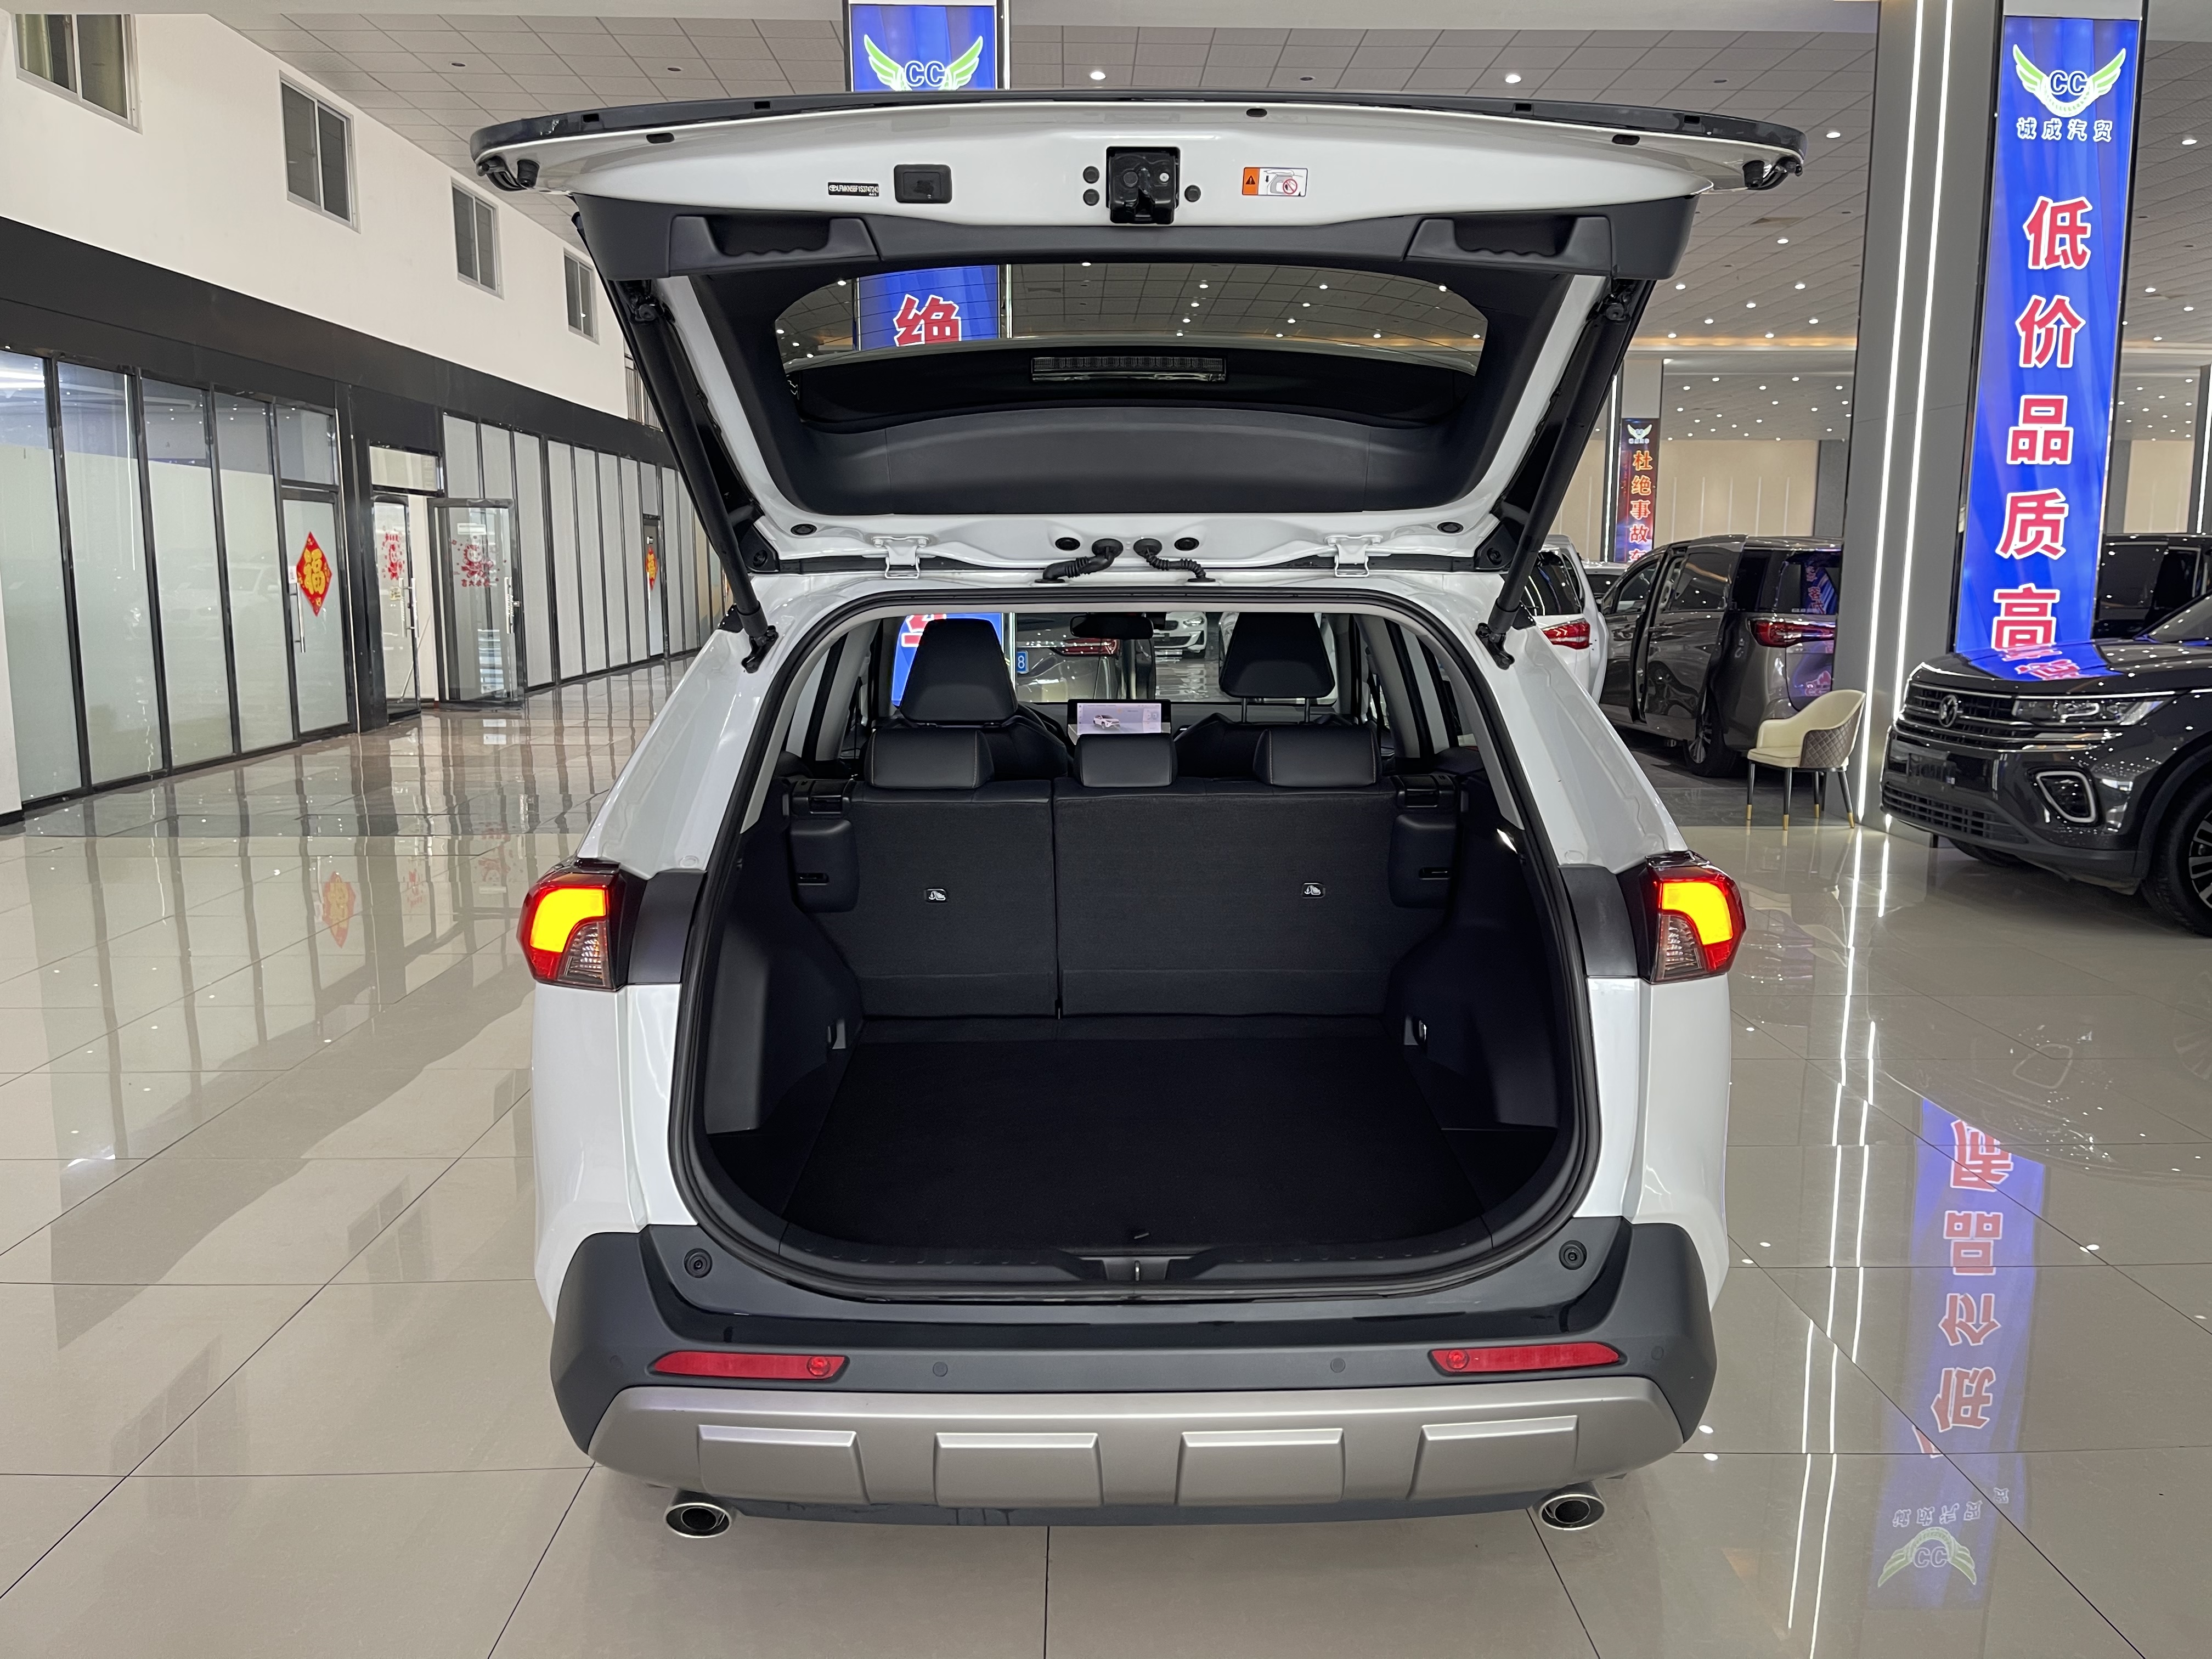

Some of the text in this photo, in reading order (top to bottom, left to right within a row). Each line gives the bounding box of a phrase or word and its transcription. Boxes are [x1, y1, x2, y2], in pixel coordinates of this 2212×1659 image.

[904, 60, 946, 87] CC
[2049, 70, 2089, 95] CC
[2016, 117, 2113, 142] 诚成汽贸
[894, 294, 961, 347] 绝
[1991, 196, 2093, 651] 低价品质高
[304, 548, 326, 595] 福
